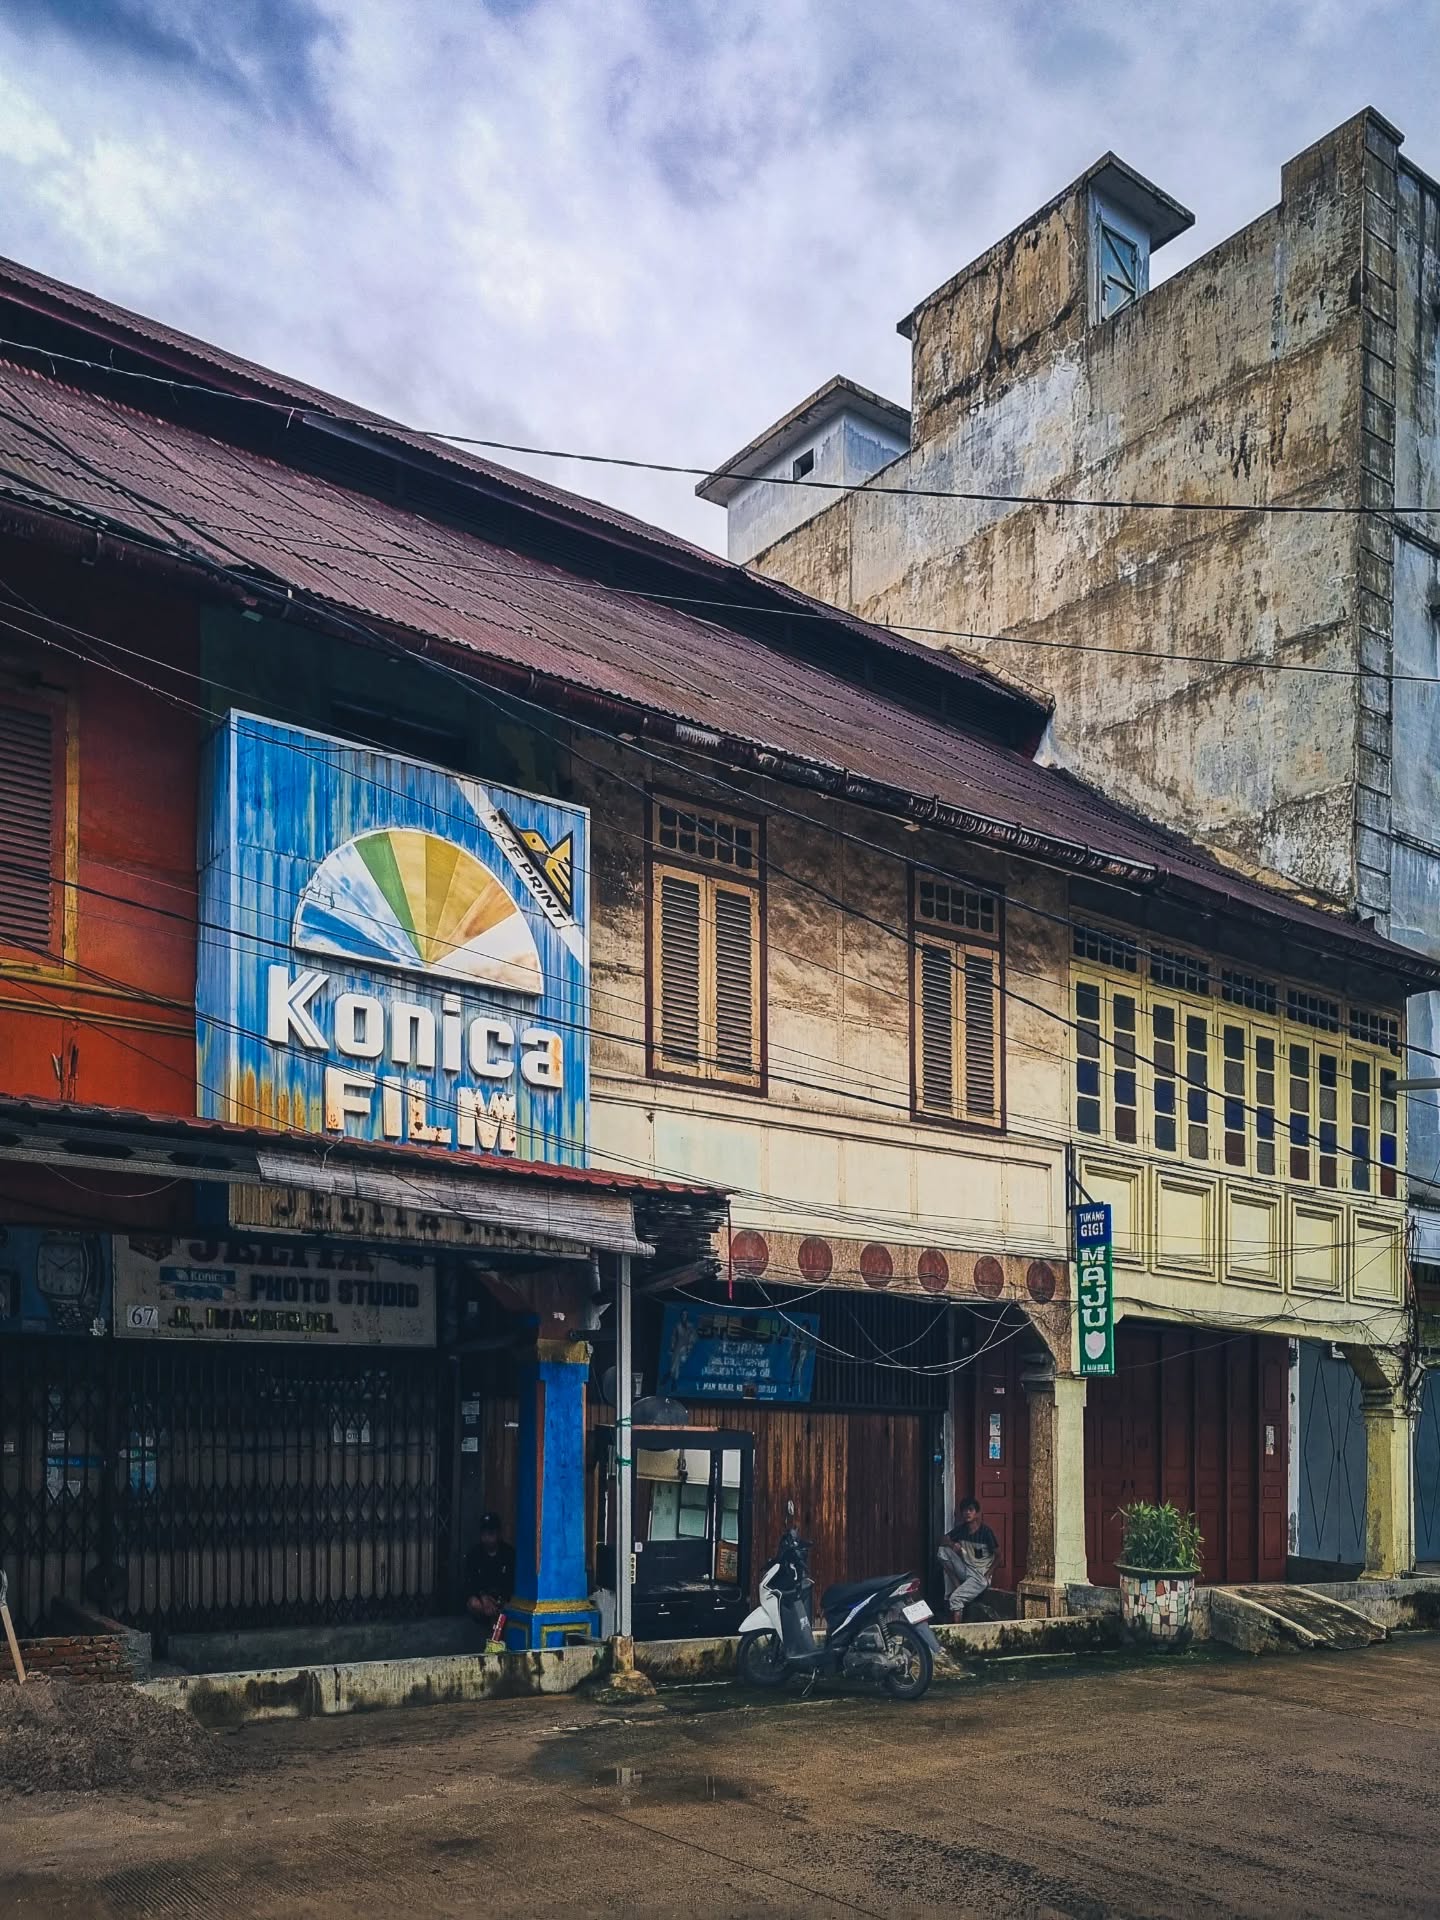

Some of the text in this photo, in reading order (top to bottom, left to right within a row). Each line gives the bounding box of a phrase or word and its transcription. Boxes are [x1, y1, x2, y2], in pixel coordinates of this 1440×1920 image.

[520, 862, 567, 921] PRINT
[268, 964, 564, 1089] Konica
[325, 1066, 516, 1152] FILM
[1079, 1210, 1105, 1224] TUKANG
[1080, 1222, 1104, 1237] GIGI
[251, 1274, 420, 1309] PHOTO STUDIO
[1080, 1245, 1107, 1327] MAJU
[131, 1306, 154, 1327] 67
